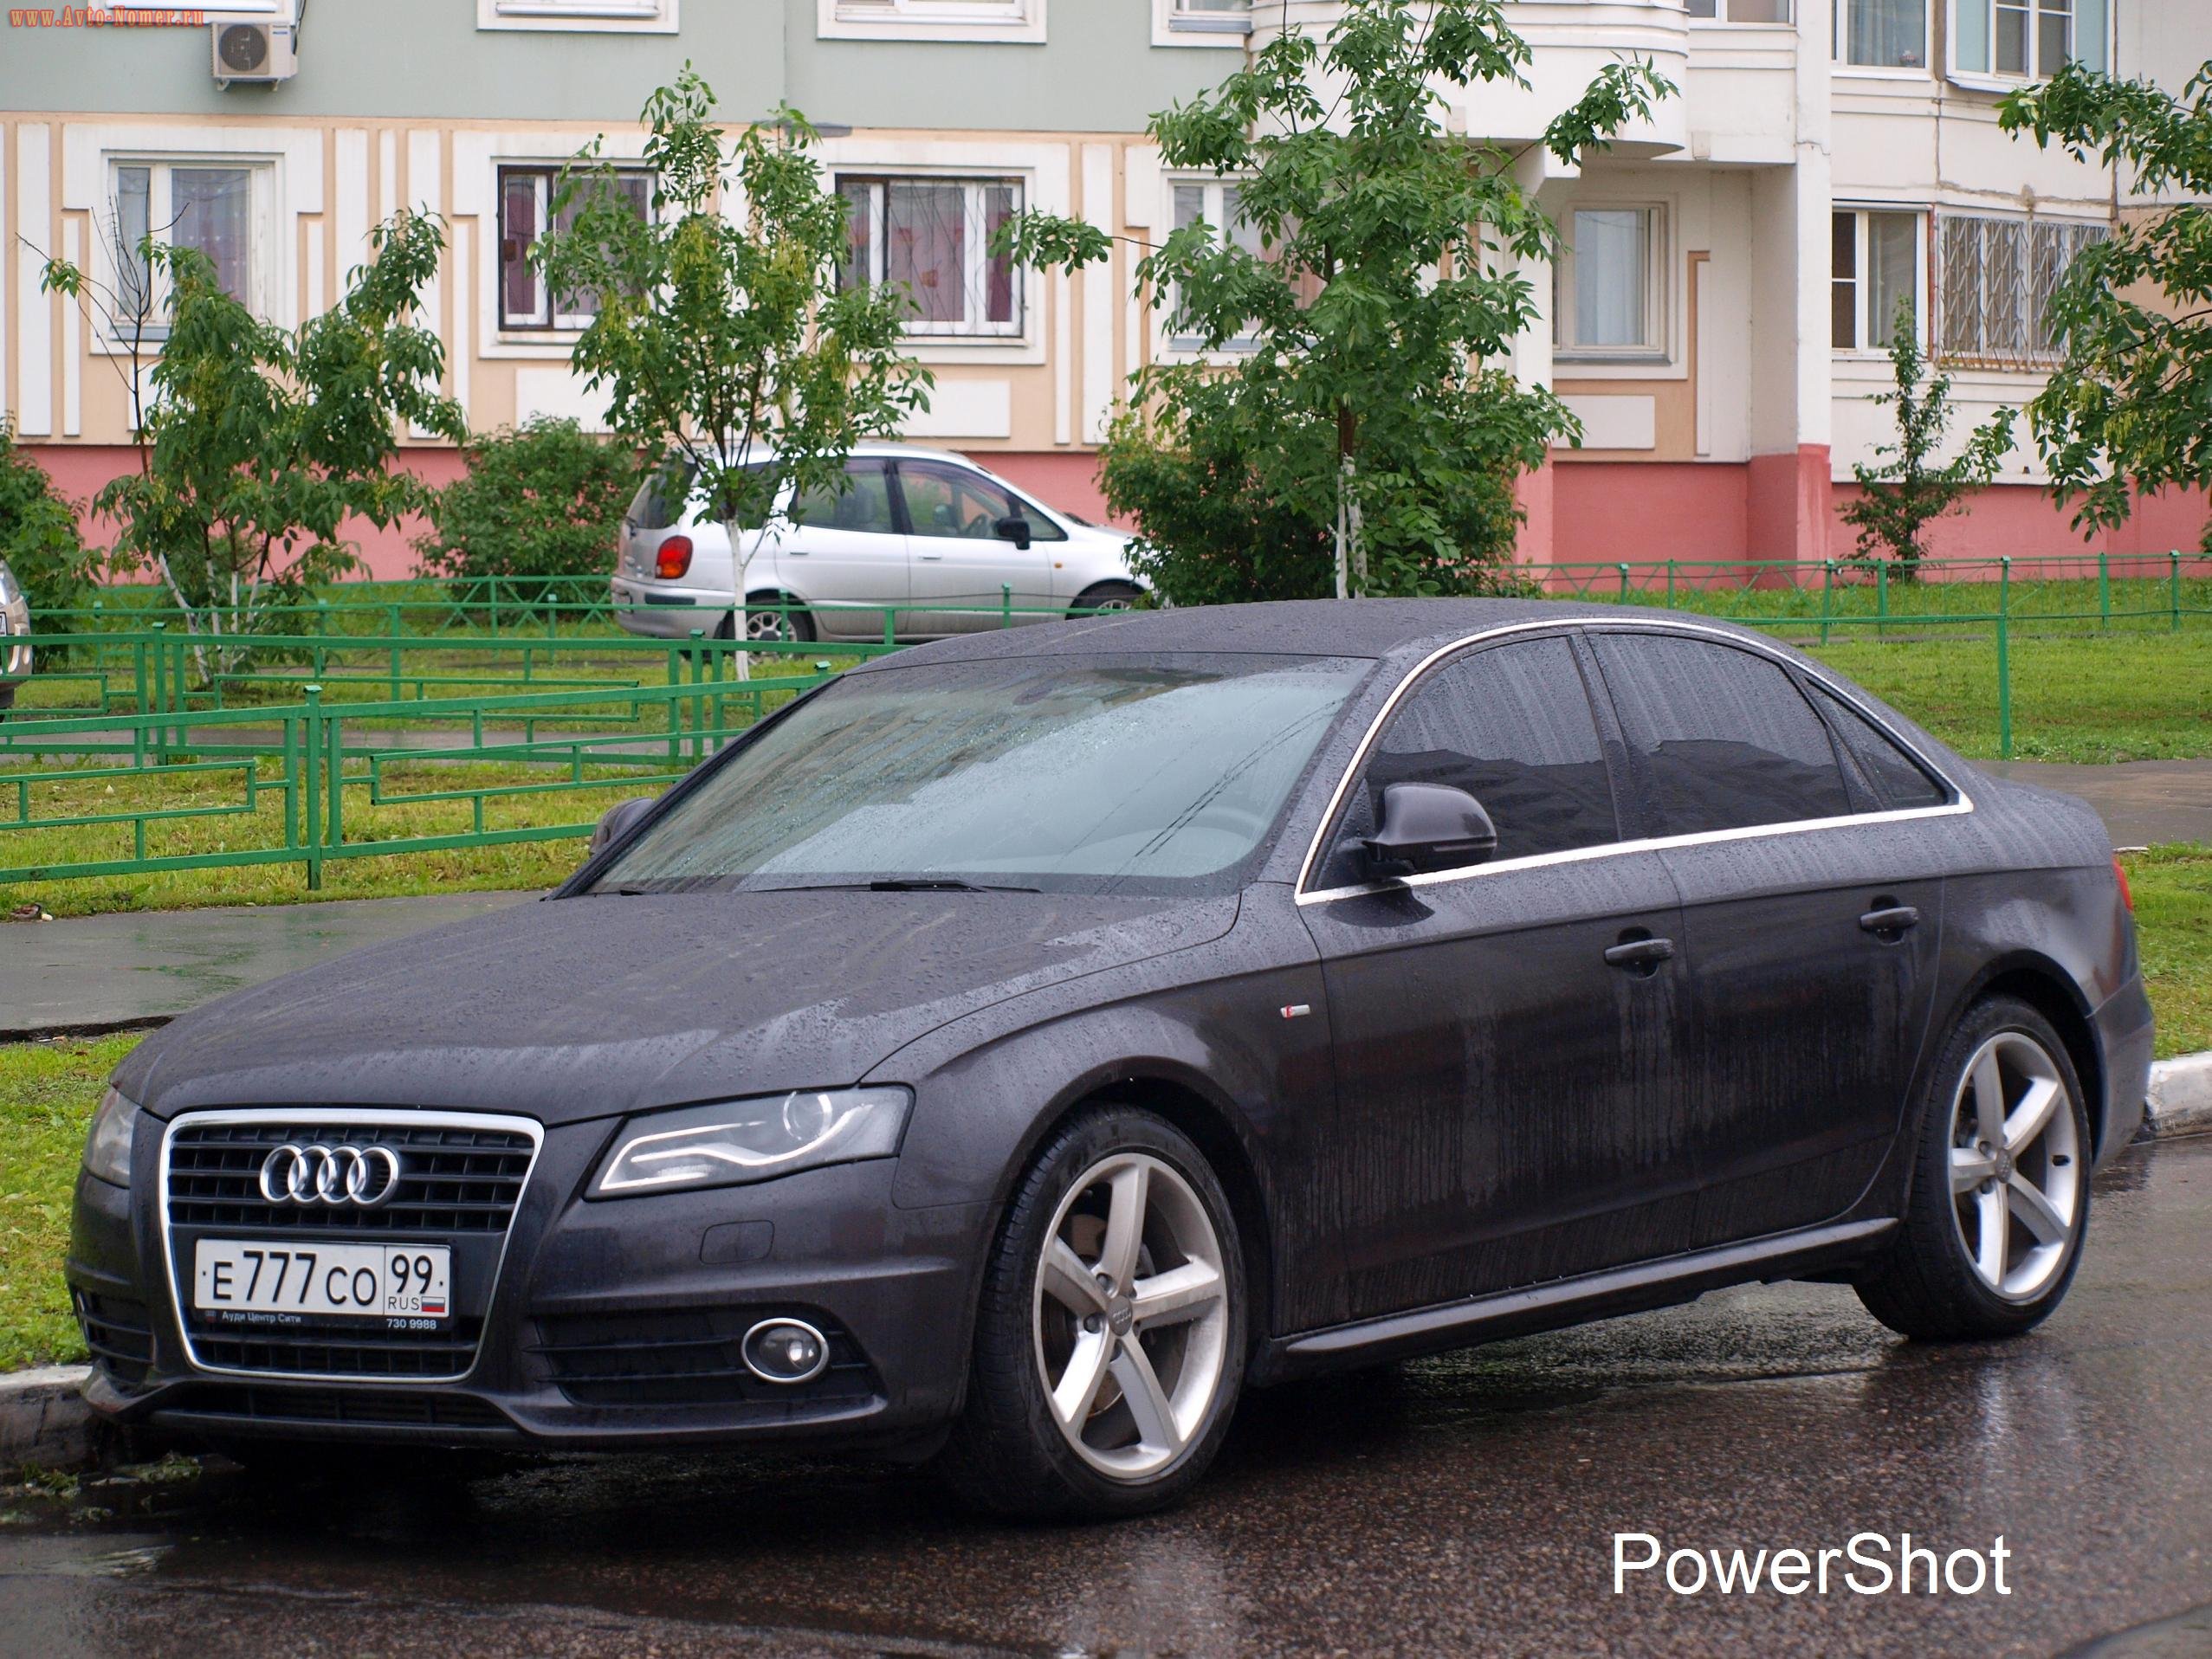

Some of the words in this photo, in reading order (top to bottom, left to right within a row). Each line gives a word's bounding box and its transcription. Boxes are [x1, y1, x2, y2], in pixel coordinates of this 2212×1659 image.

[391, 1254, 432, 1294] 99
[387, 1296, 419, 1310] RUS
[386, 1318, 406, 1328] 730
